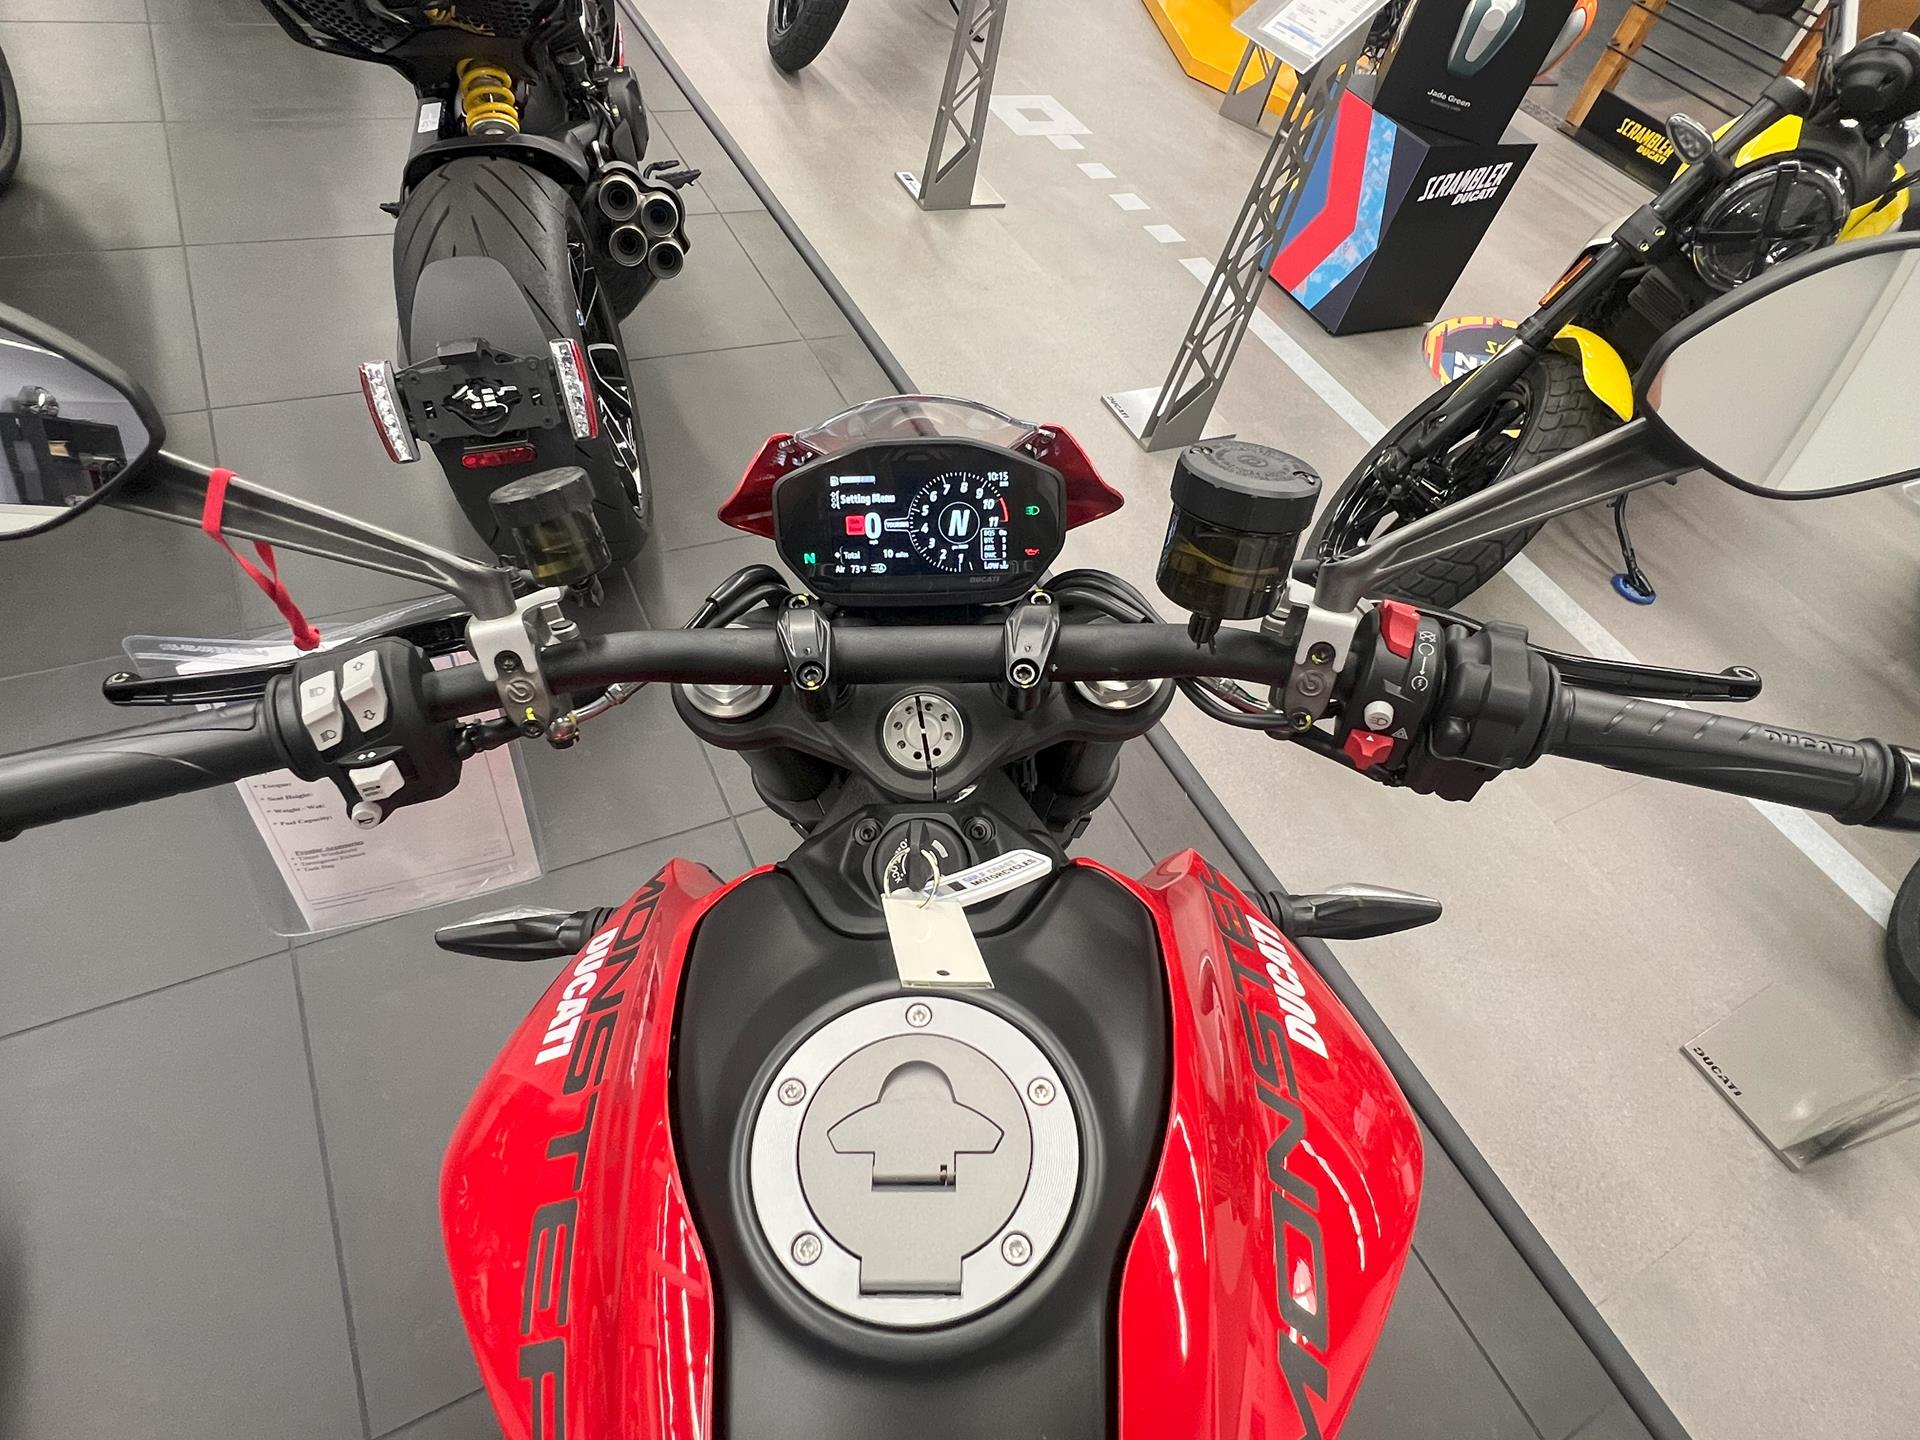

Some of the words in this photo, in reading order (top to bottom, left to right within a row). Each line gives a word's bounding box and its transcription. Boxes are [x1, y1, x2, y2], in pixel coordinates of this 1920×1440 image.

[1427, 89, 1447, 101] Jade
[1447, 94, 1471, 108] Green
[1636, 144, 1667, 165] DUCATI
[1417, 162, 1513, 202] SCRAMBLER
[1451, 186, 1498, 206] DUCATI
[987, 472, 1008, 481] 10:15
[943, 484, 951, 495] 7
[960, 482, 968, 493] 8
[929, 491, 938, 502] 6
[976, 488, 984, 499] 9
[840, 494, 871, 506] Setting
[872, 493, 896, 503] Menu
[983, 499, 995, 510] 10
[921, 505, 930, 516] 5
[865, 512, 882, 539] 0
[948, 509, 971, 537] N
[989, 516, 1000, 527] 11
[921, 522, 929, 533] 4
[928, 537, 936, 549] 3
[803, 552, 816, 564] N
[843, 550, 861, 560] Total
[883, 549, 894, 559] 10
[940, 549, 948, 560] 2
[958, 553, 965, 563] 1
[835, 565, 846, 574] Air
[983, 561, 1000, 570] Low
[1764, 729, 1856, 757] DUCATI
[971, 858, 1038, 887] MOTORCYCLES
[1245, 913, 1329, 1060] DUCATI
[534, 926, 620, 1066] DUCATI
[1693, 1047, 1742, 1096] DUCATI
